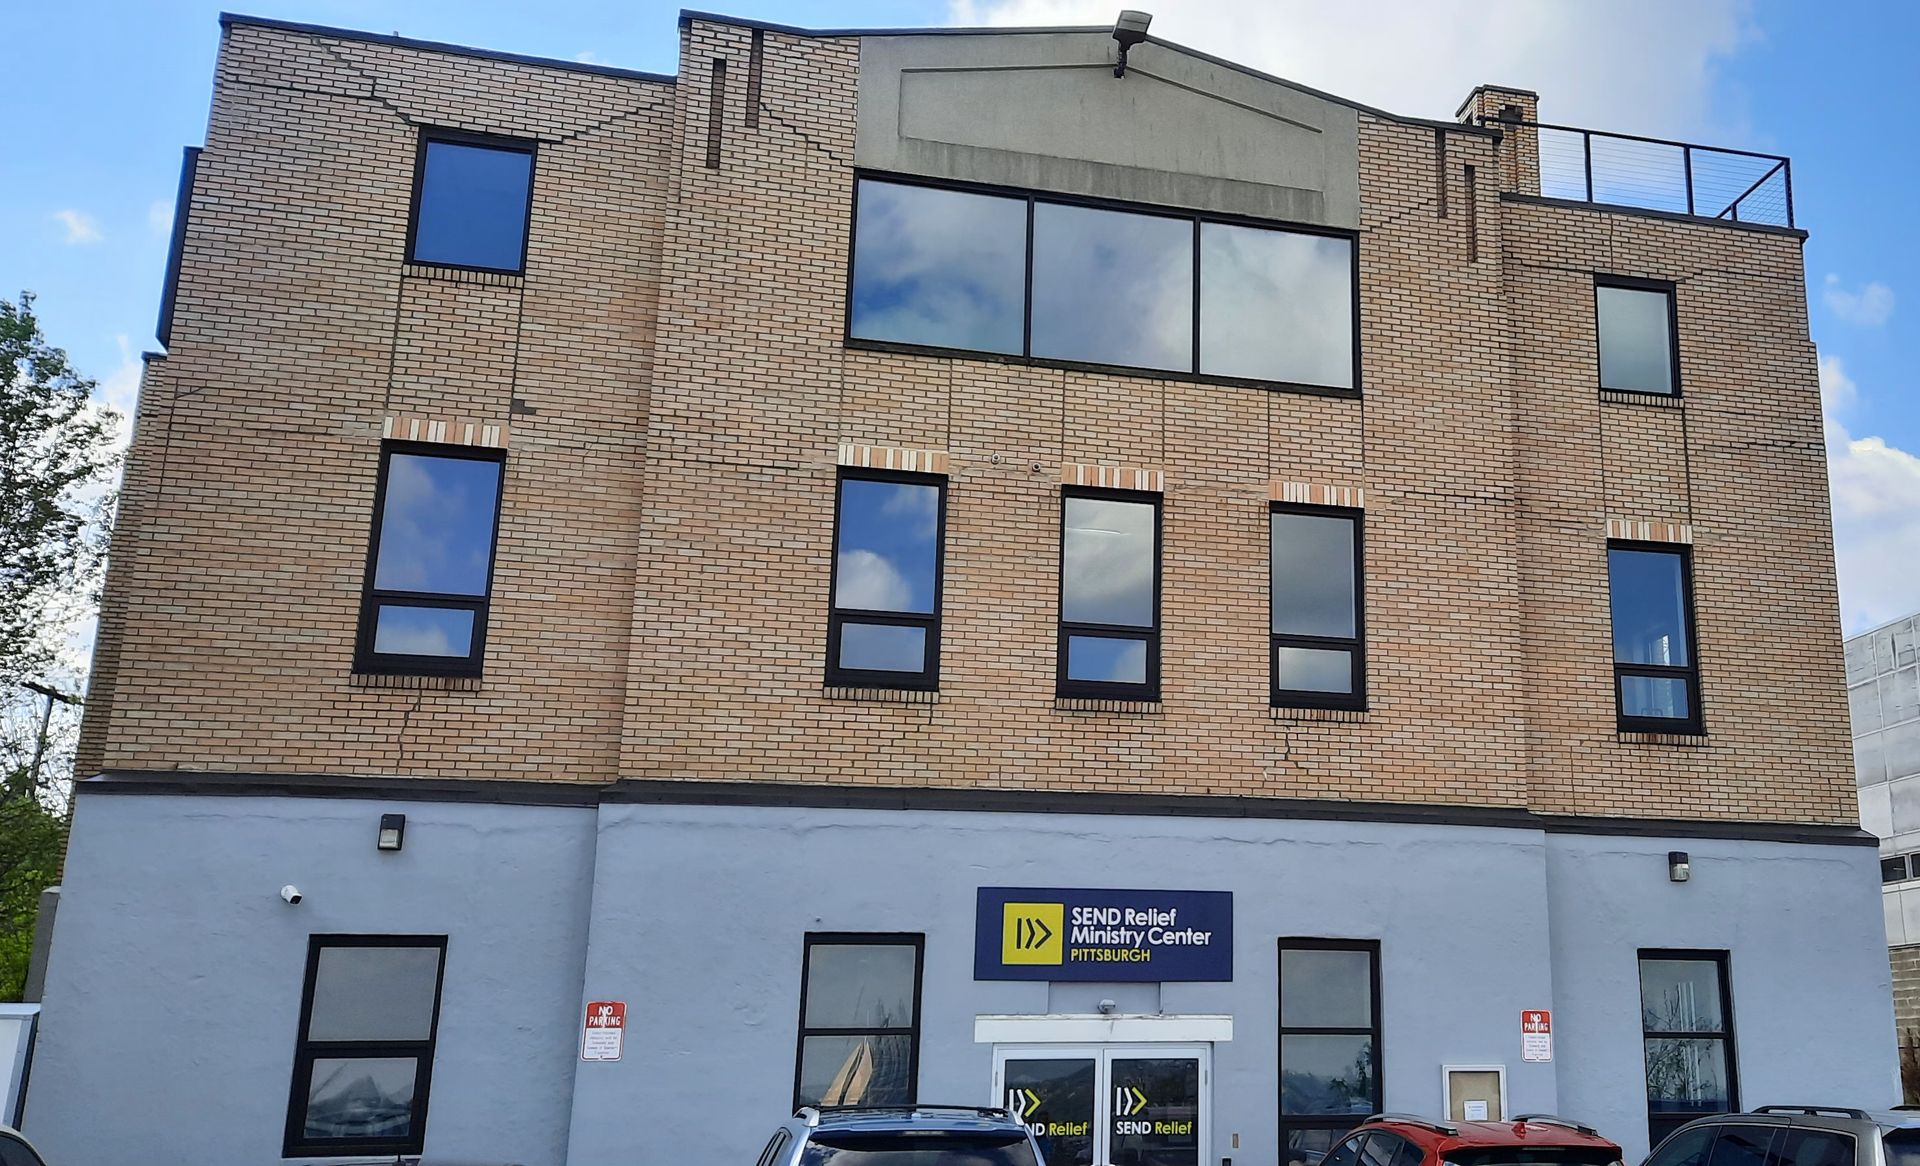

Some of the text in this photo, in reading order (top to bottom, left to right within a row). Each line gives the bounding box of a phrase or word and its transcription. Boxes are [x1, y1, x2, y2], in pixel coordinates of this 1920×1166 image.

[1071, 907, 1177, 926] SEND Relief
[1070, 926, 1212, 949] Ministry Center
[1070, 948, 1151, 962] PITTSBURGH
[598, 1005, 613, 1016] NO
[1530, 1013, 1541, 1022] NO
[589, 1016, 621, 1026] PARKING
[1025, 1121, 1088, 1136] ND Relief
[1116, 1120, 1192, 1135] SEND Relief
